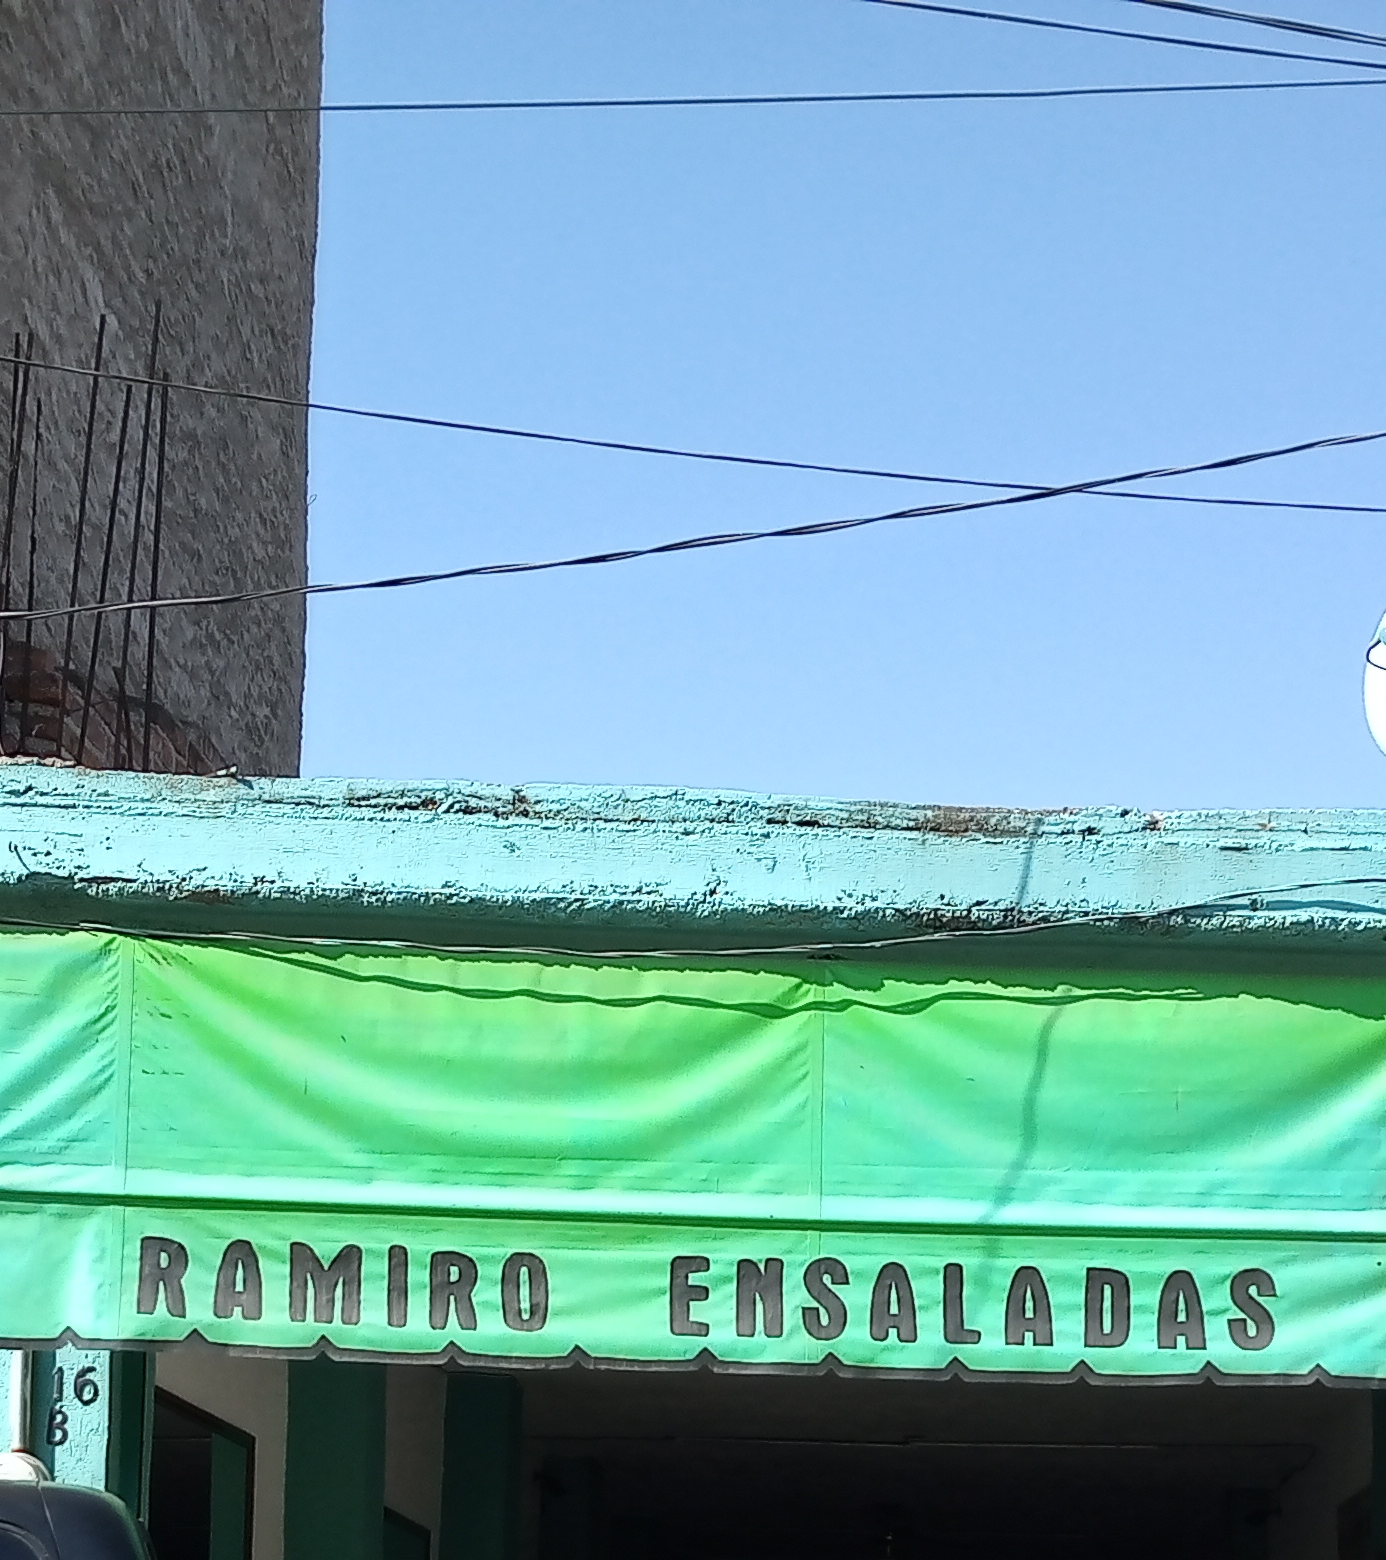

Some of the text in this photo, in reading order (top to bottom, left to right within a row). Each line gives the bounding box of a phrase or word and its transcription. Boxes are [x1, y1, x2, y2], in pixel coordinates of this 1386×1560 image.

[137, 1235, 1280, 1353] RAMIRO ENSALADAS
[52, 1365, 99, 1406] 16
